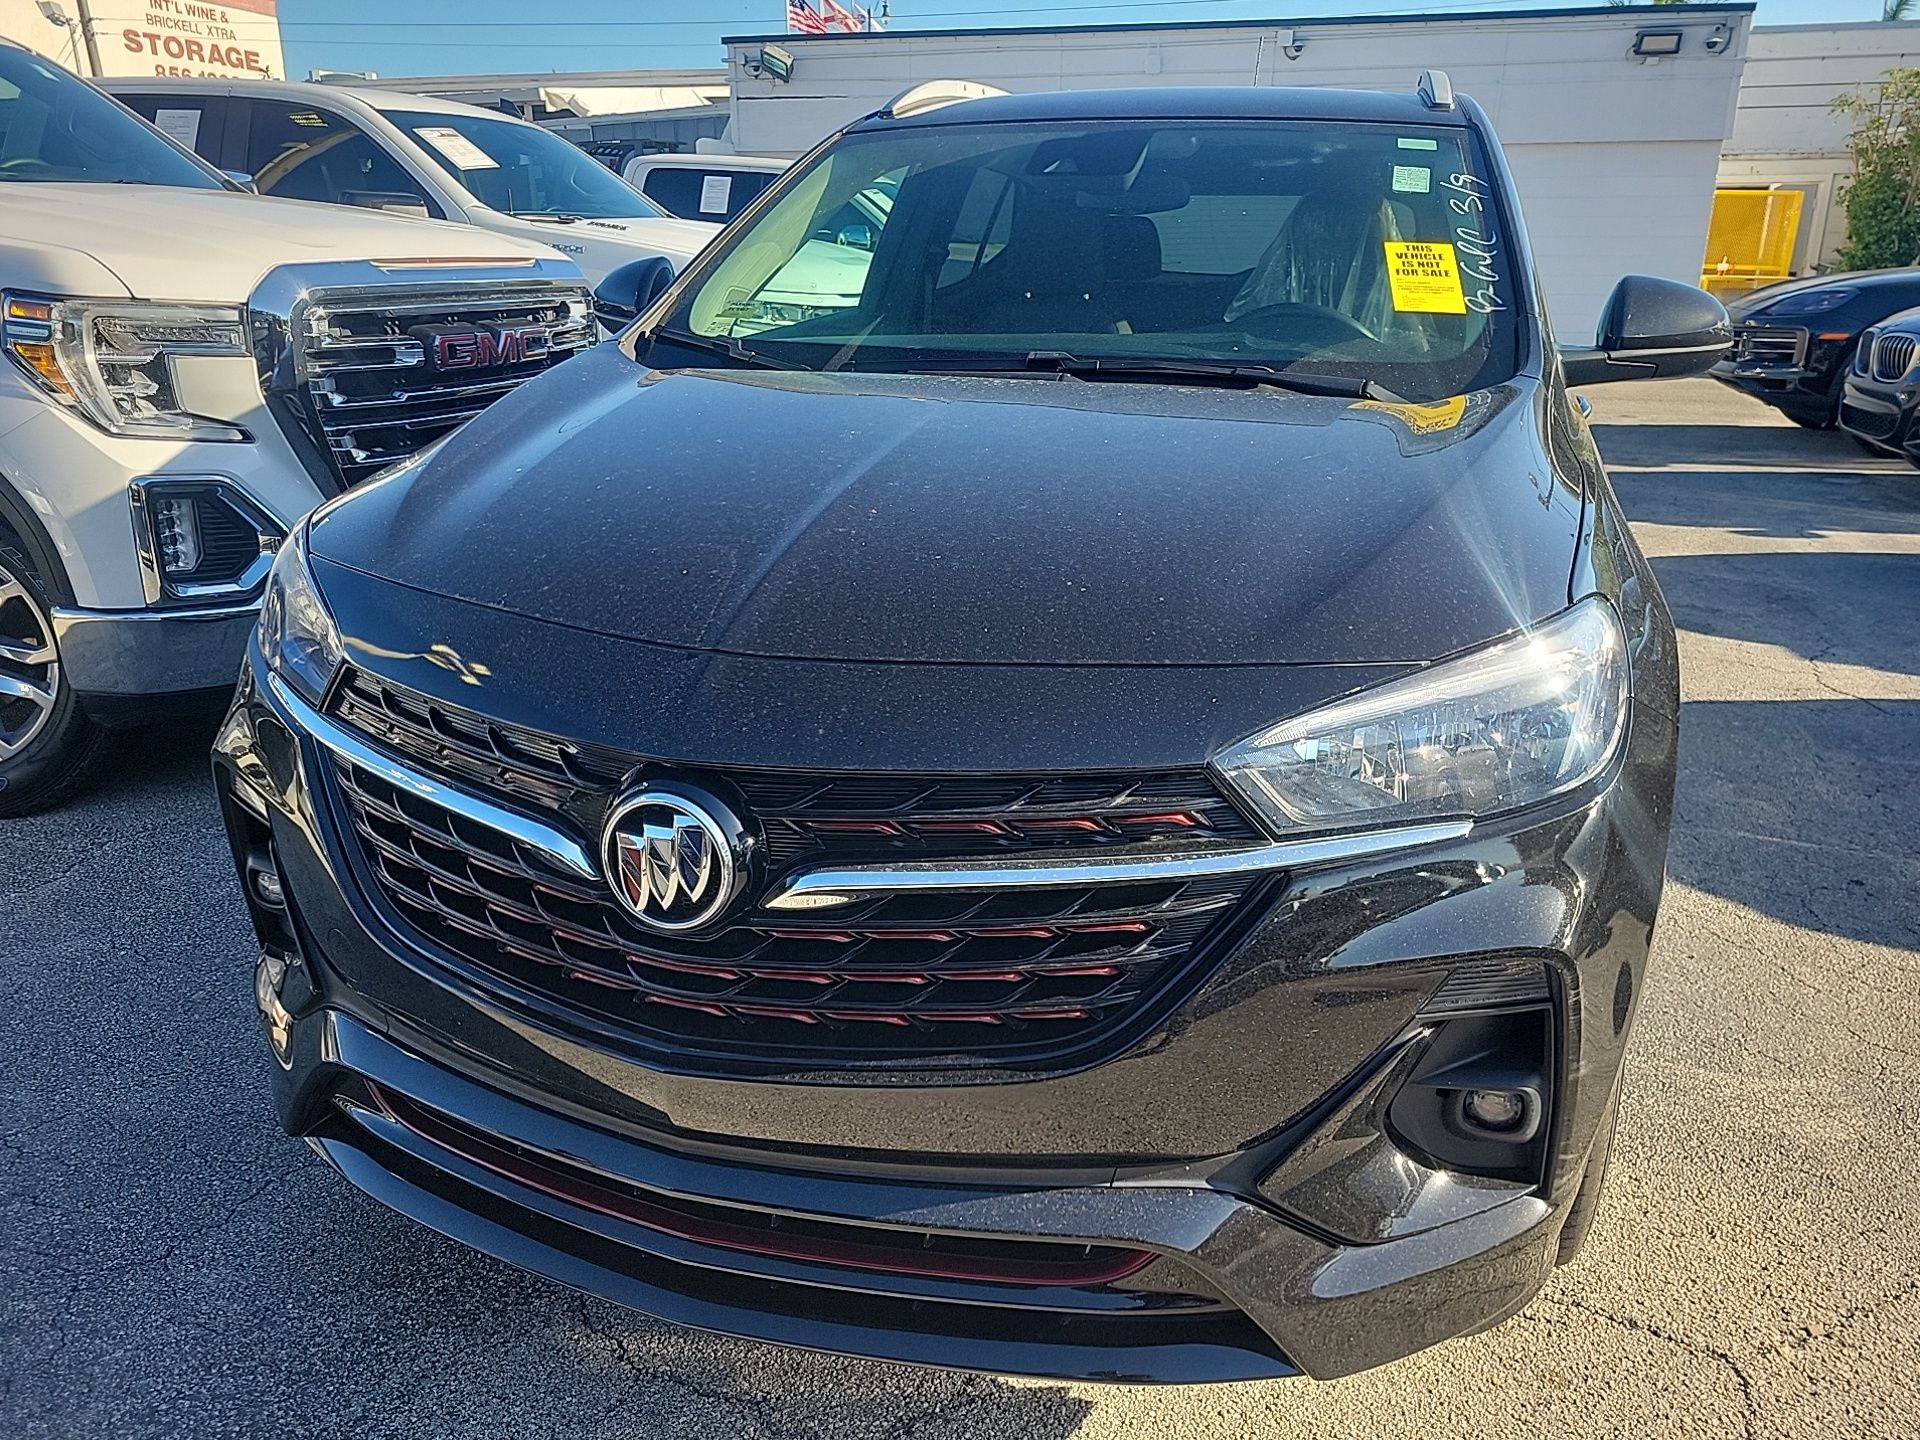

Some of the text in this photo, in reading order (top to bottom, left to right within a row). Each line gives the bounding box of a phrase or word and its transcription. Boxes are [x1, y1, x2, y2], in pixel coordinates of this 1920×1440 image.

[150, 0, 229, 23] INT'L WINE &
[146, 13, 237, 41] BRICKELL XTRA
[123, 28, 261, 72] STORAGE
[1405, 244, 1433, 252] THIS
[1395, 252, 1445, 261] VEHICLE
[1401, 260, 1441, 269] IS NOT
[1395, 268, 1451, 278] FOR SALE
[437, 328, 548, 369] GMC
